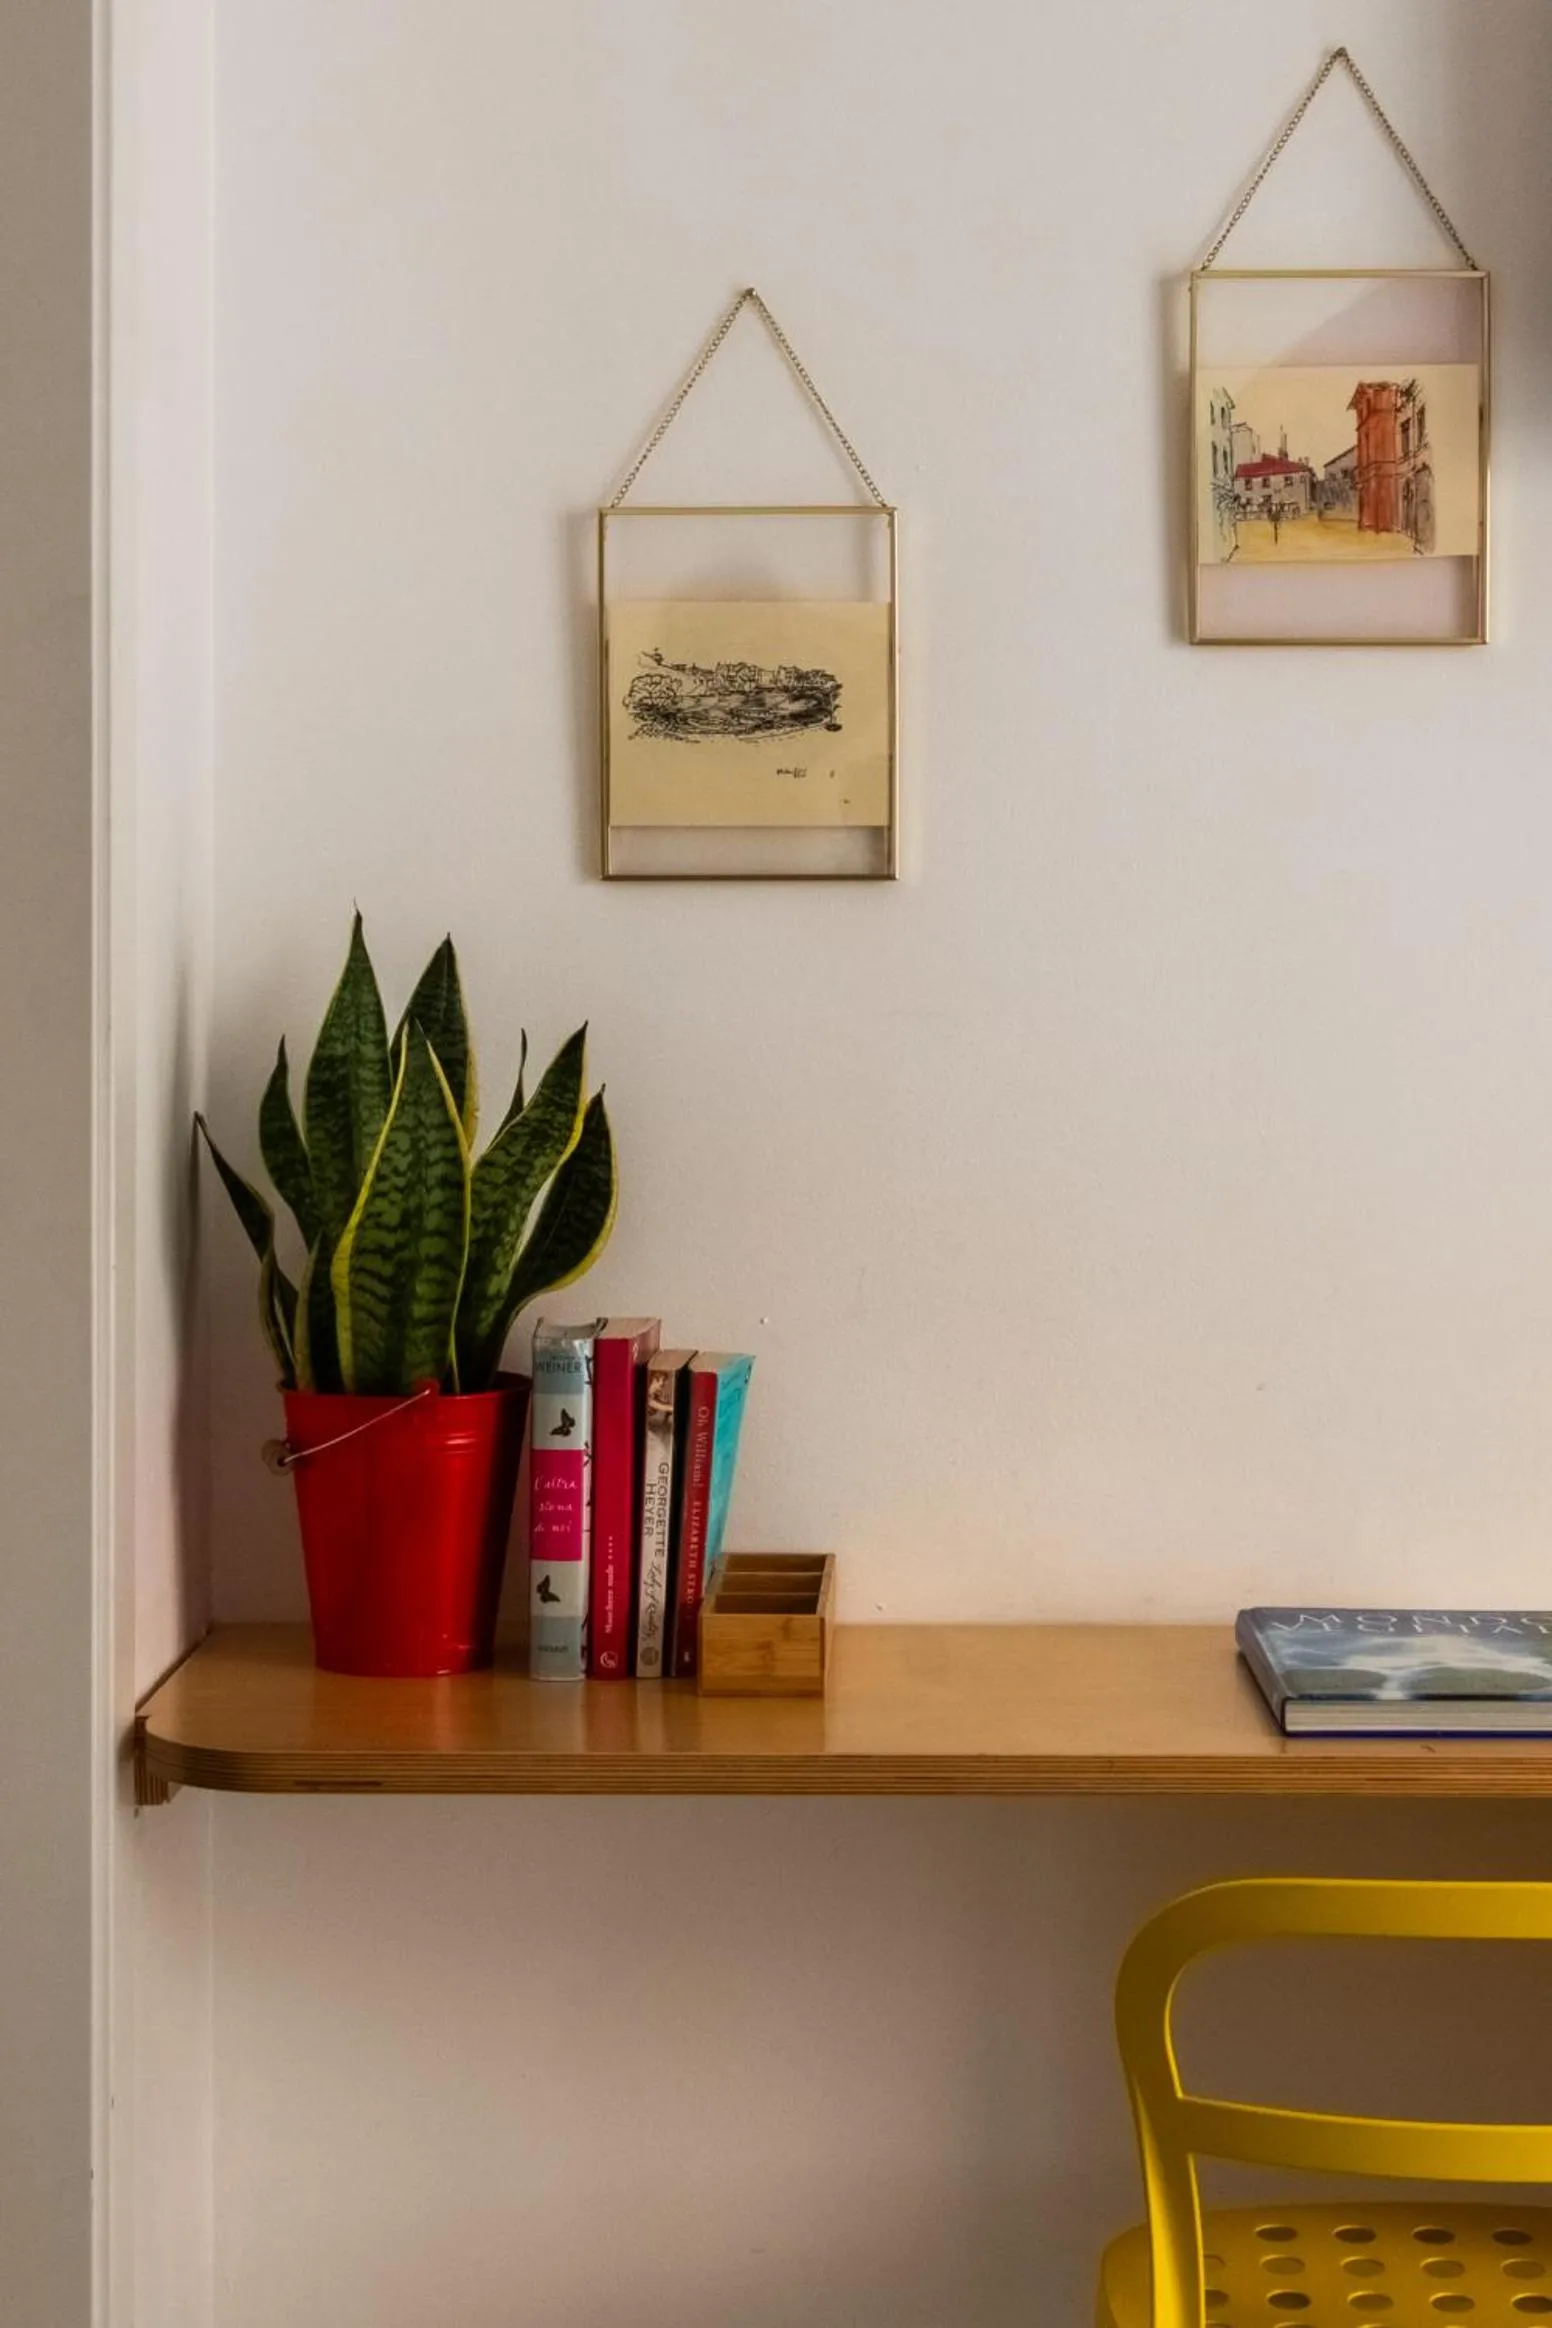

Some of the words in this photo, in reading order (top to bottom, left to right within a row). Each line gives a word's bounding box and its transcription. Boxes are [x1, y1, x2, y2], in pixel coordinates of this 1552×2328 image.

[697, 1405, 710, 1427] Oh
[643, 1483, 657, 1537] HEYER
[654, 1461, 670, 1558] GEORGETTE
[688, 1501, 701, 1569] ELIZABETH
